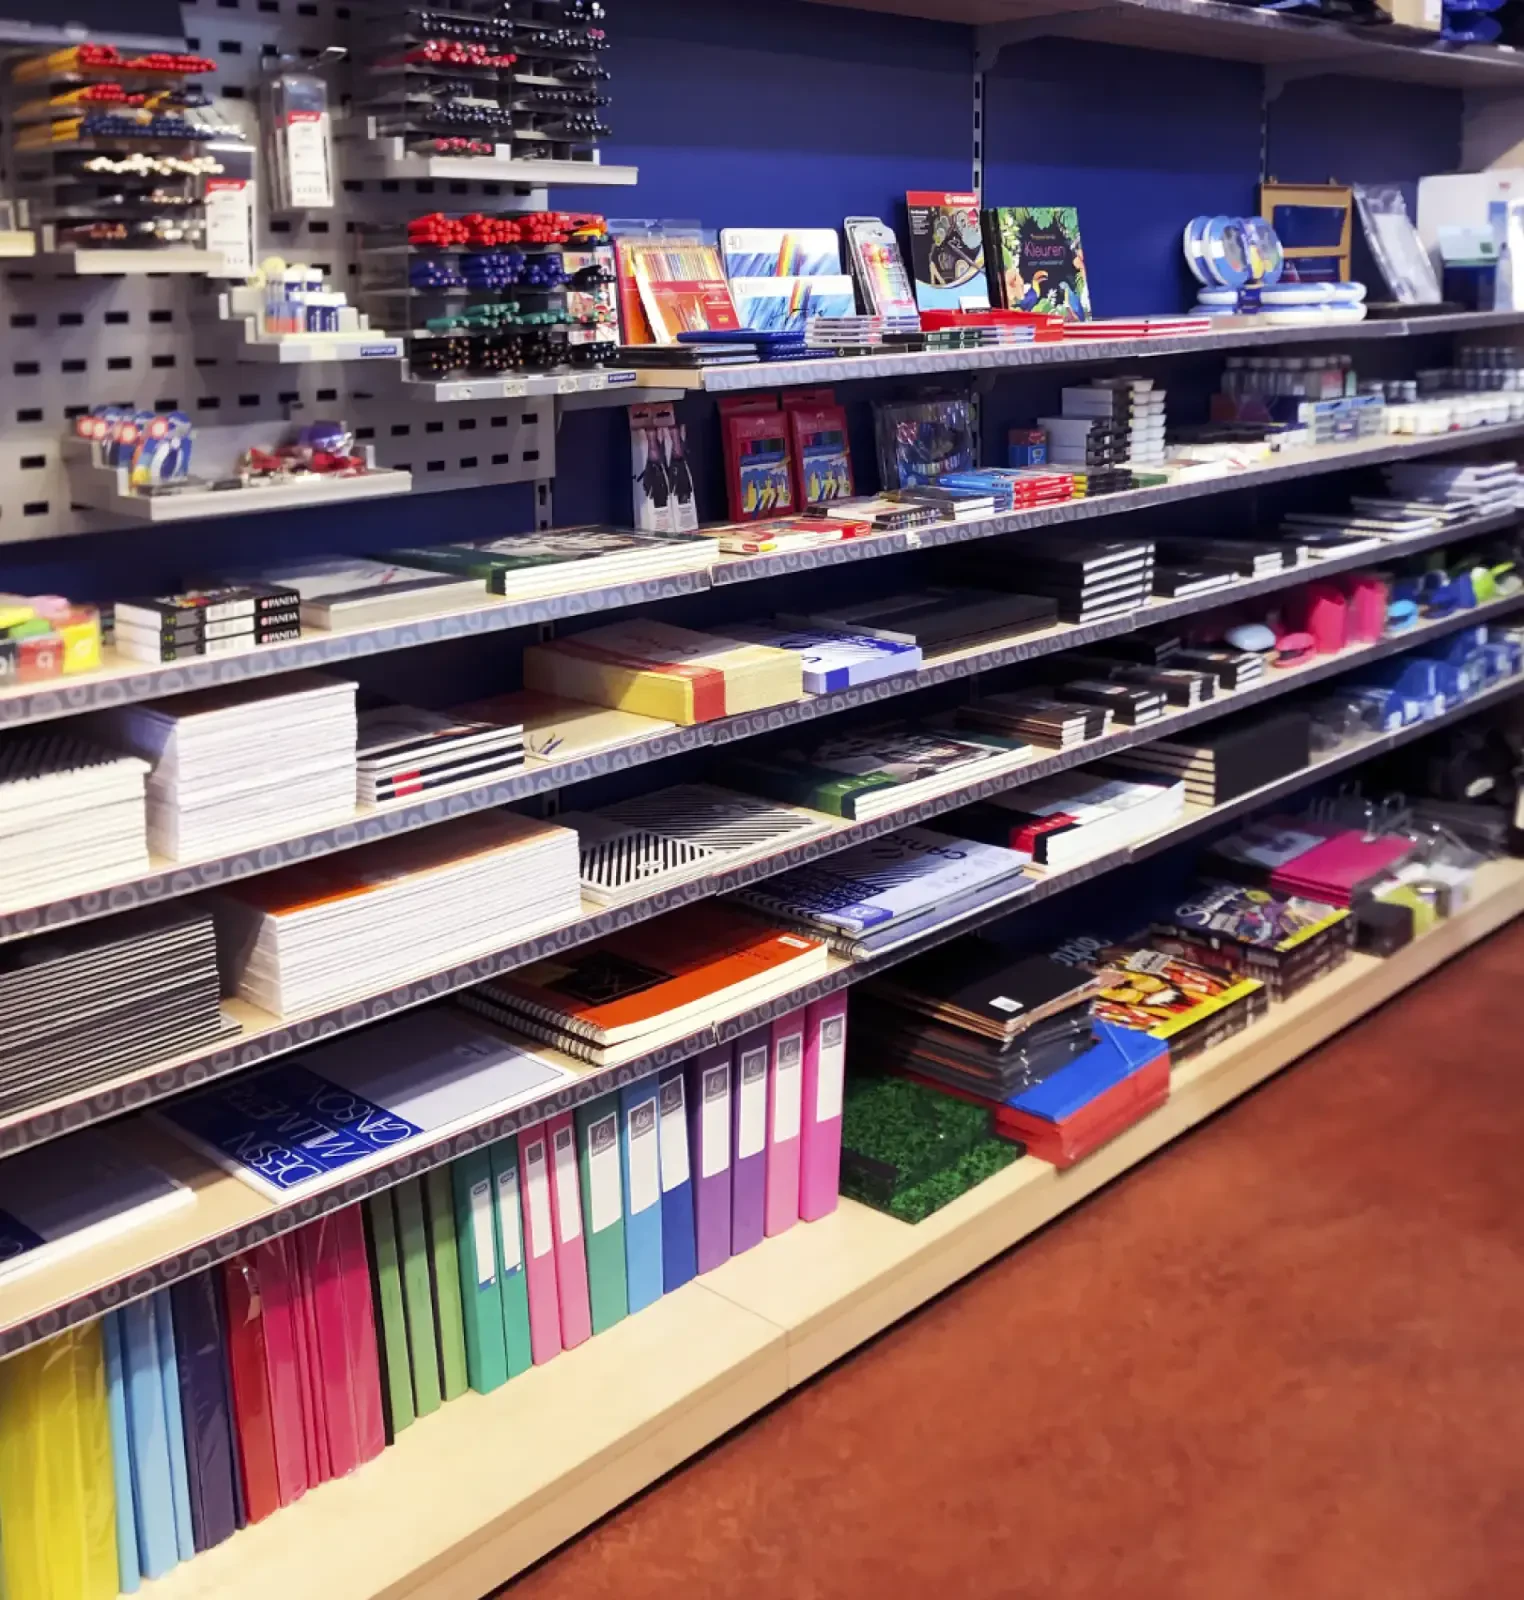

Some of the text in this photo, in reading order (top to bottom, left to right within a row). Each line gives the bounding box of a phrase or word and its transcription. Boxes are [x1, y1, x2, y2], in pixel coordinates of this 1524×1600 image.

[1024, 240, 1065, 257] Kleuren
[268, 595, 299, 609] PANDA
[268, 612, 298, 626] PANDA
[268, 629, 299, 643] PANDA
[307, 1083, 412, 1143] CANSON
[221, 1130, 322, 1186] DESSIN
